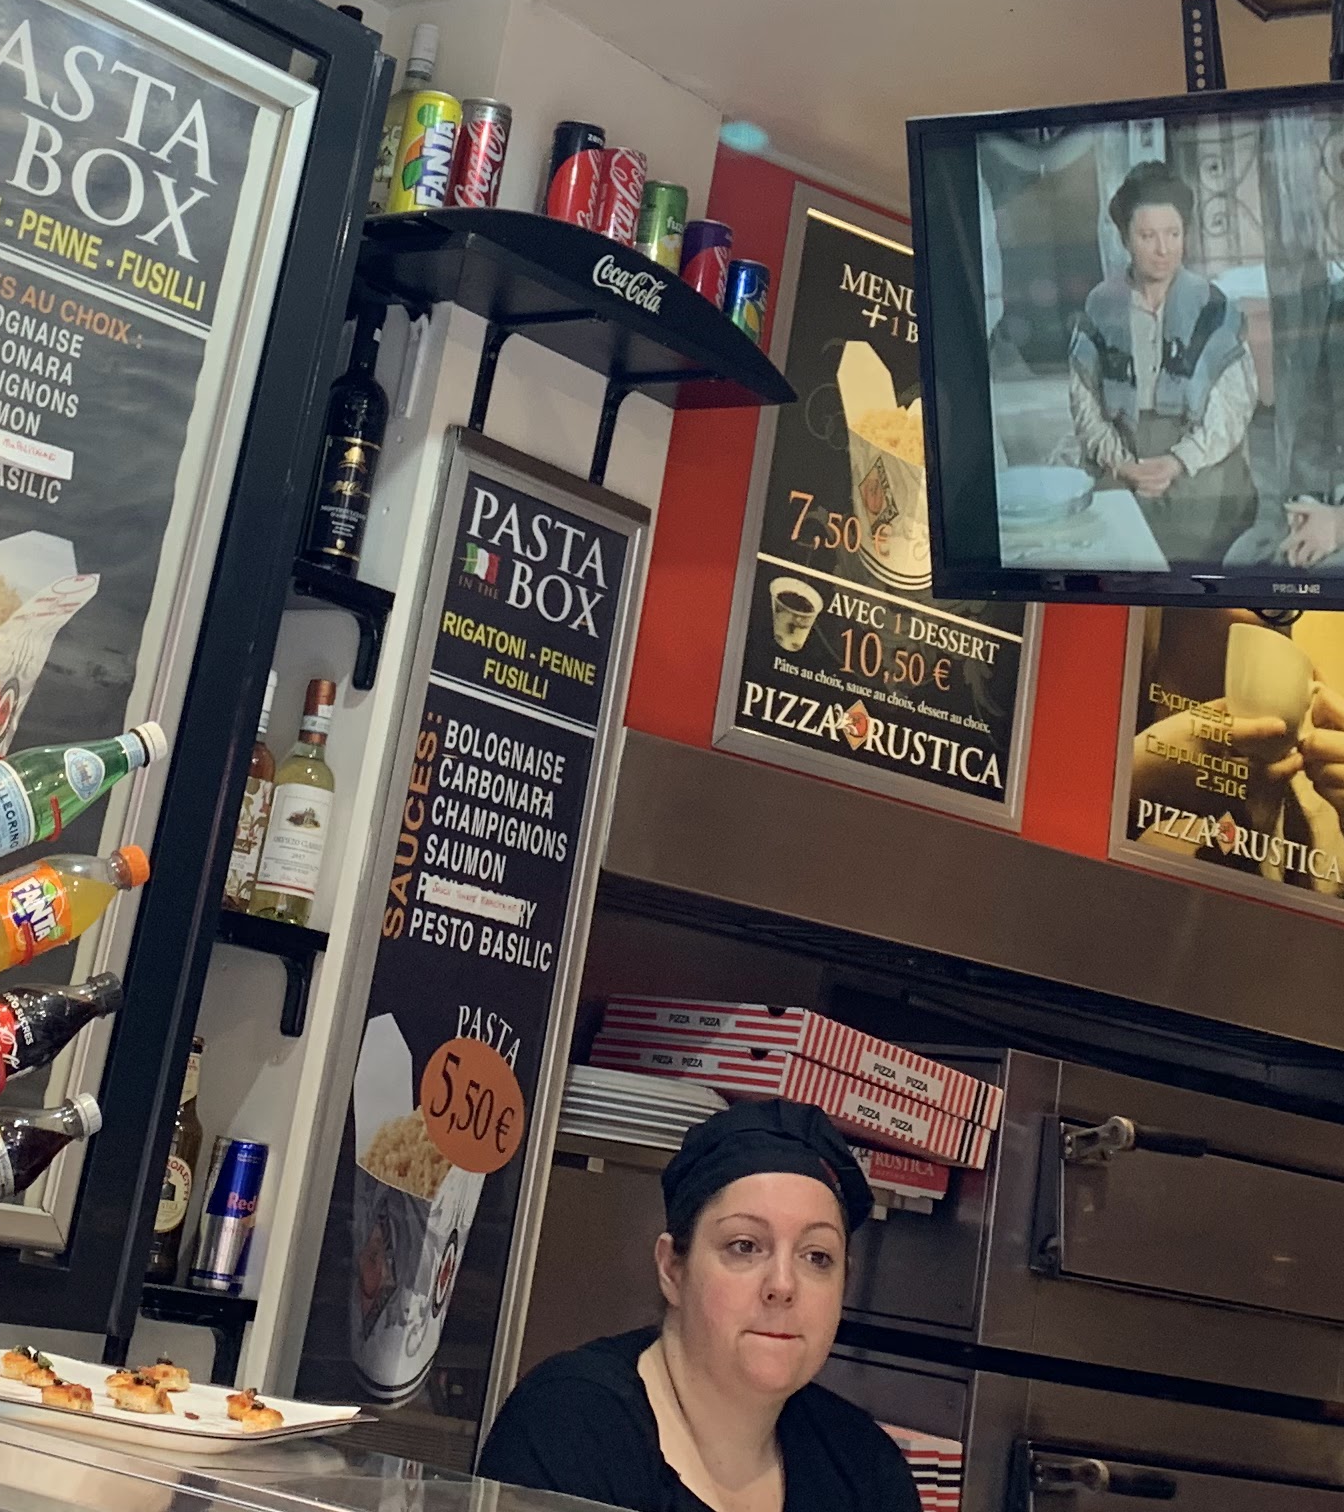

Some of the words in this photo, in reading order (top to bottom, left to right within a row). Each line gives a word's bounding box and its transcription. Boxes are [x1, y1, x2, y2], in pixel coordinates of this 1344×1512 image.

[6, 112, 209, 263] BOX
[415, 121, 456, 207] FANTA
[18, 209, 103, 270] PENNE
[117, 249, 206, 311] FUSILLI
[592, 254, 669, 315] Coca-Cola
[21, 285, 55, 314] AU
[60, 300, 132, 345] CHOIX
[466, 487, 608, 589] PASTA
[789, 490, 862, 553] 7,50
[873, 524, 891, 557] €
[458, 574, 472, 589] IN
[476, 582, 500, 600] THE
[505, 559, 605, 638] BOX
[442, 610, 527, 661] RIGATONI
[539, 646, 596, 686] PENNE
[827, 592, 887, 630] AVEC
[894, 613, 903, 634] 1
[909, 617, 1000, 665] DESSERT
[840, 628, 925, 687] 10,50
[932, 658, 952, 692] €
[483, 657, 550, 701] FUSILLI
[773, 655, 799, 677] Pâtes
[800, 666, 814, 680] au
[815, 668, 846, 691] choix,
[846, 681, 872, 699] sauce
[873, 688, 886, 702] au
[887, 689, 916, 712] choix,
[917, 701, 948, 720] dessert
[949, 710, 962, 724] au
[963, 713, 991, 735] choix.
[1149, 682, 1234, 728] Expresso
[444, 719, 566, 785] BOLOGNAISE
[742, 681, 841, 742] PIZZA
[864, 715, 1004, 790] RUSTICA
[1145, 734, 1250, 781] Cappuccino
[438, 758, 554, 820] CARBONARA
[383, 730, 438, 939] SAUCES
[424, 834, 507, 884] SAUMON
[431, 795, 568, 862] CHAMPIGNONS
[1137, 798, 1215, 848] PIZZA
[1233, 826, 1343, 884] RUSTICA
[11, 876, 58, 943] FANTA
[409, 908, 474, 952] PESTO
[479, 926, 553, 972] BASILIC
[15, 1008, 34, 1046] SUCRES
[456, 1004, 521, 1072] PASTA
[669, 1013, 690, 1025] PIZZA
[699, 1016, 721, 1027] PIZZA
[651, 1053, 673, 1066] PIZZA
[682, 1057, 703, 1068] PIZZA
[873, 1062, 896, 1081] PIZZA
[906, 1075, 929, 1093] PIZZA
[857, 1104, 880, 1122] PIZZA
[890, 1116, 913, 1134] PIZZA
